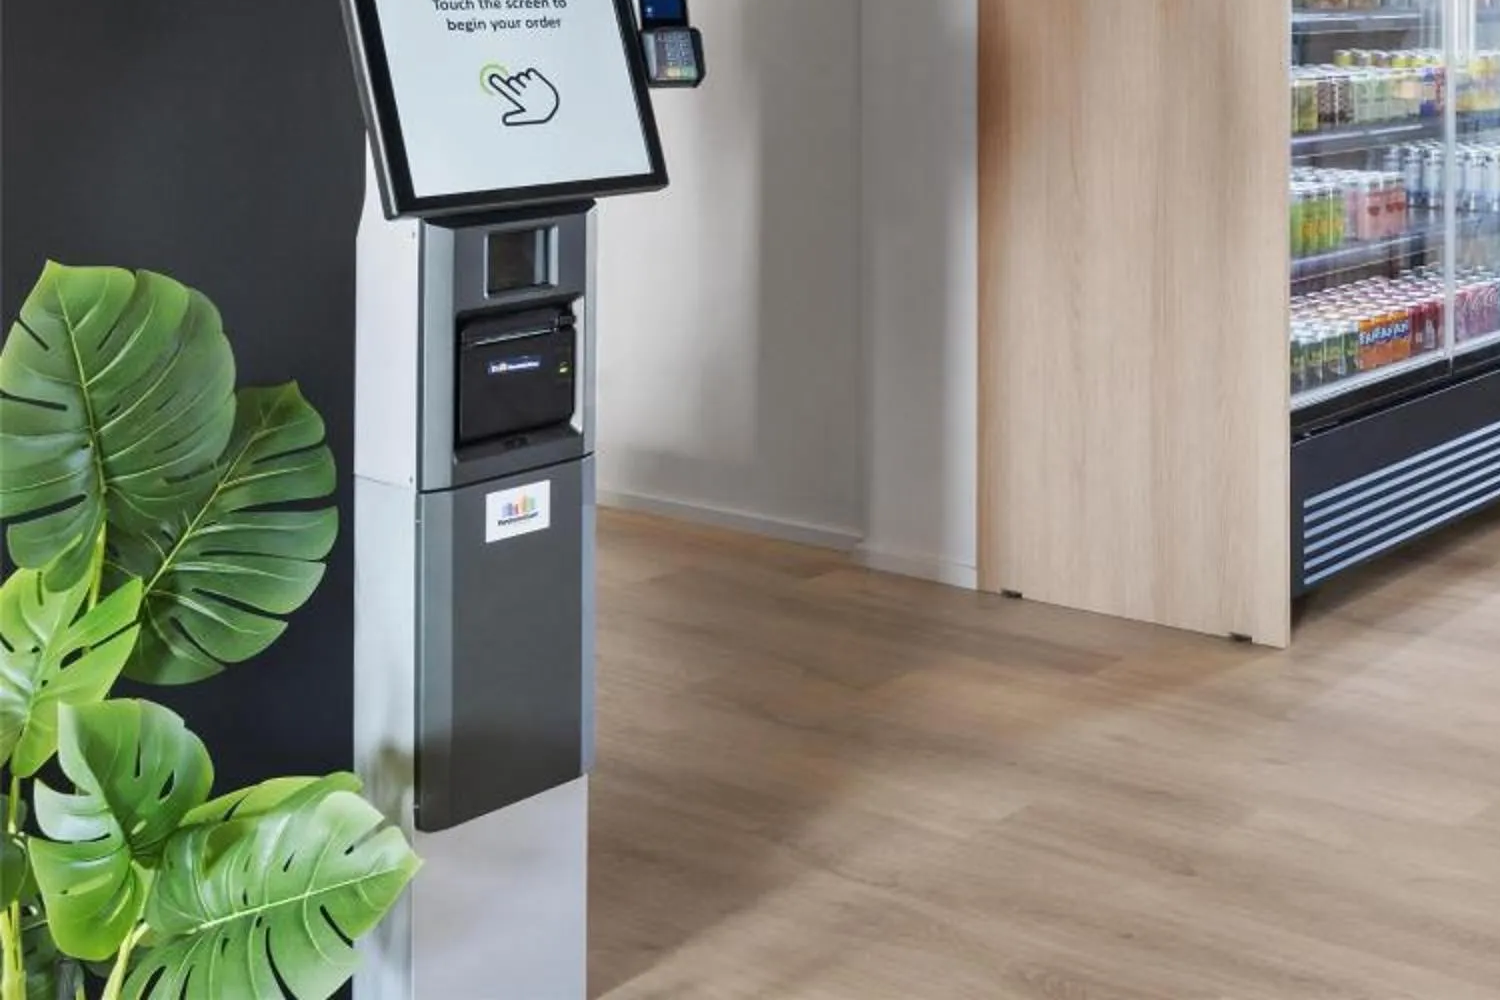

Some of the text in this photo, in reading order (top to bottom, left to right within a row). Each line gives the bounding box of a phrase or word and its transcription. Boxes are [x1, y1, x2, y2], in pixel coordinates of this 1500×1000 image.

[445, 15, 561, 32] begin your order
